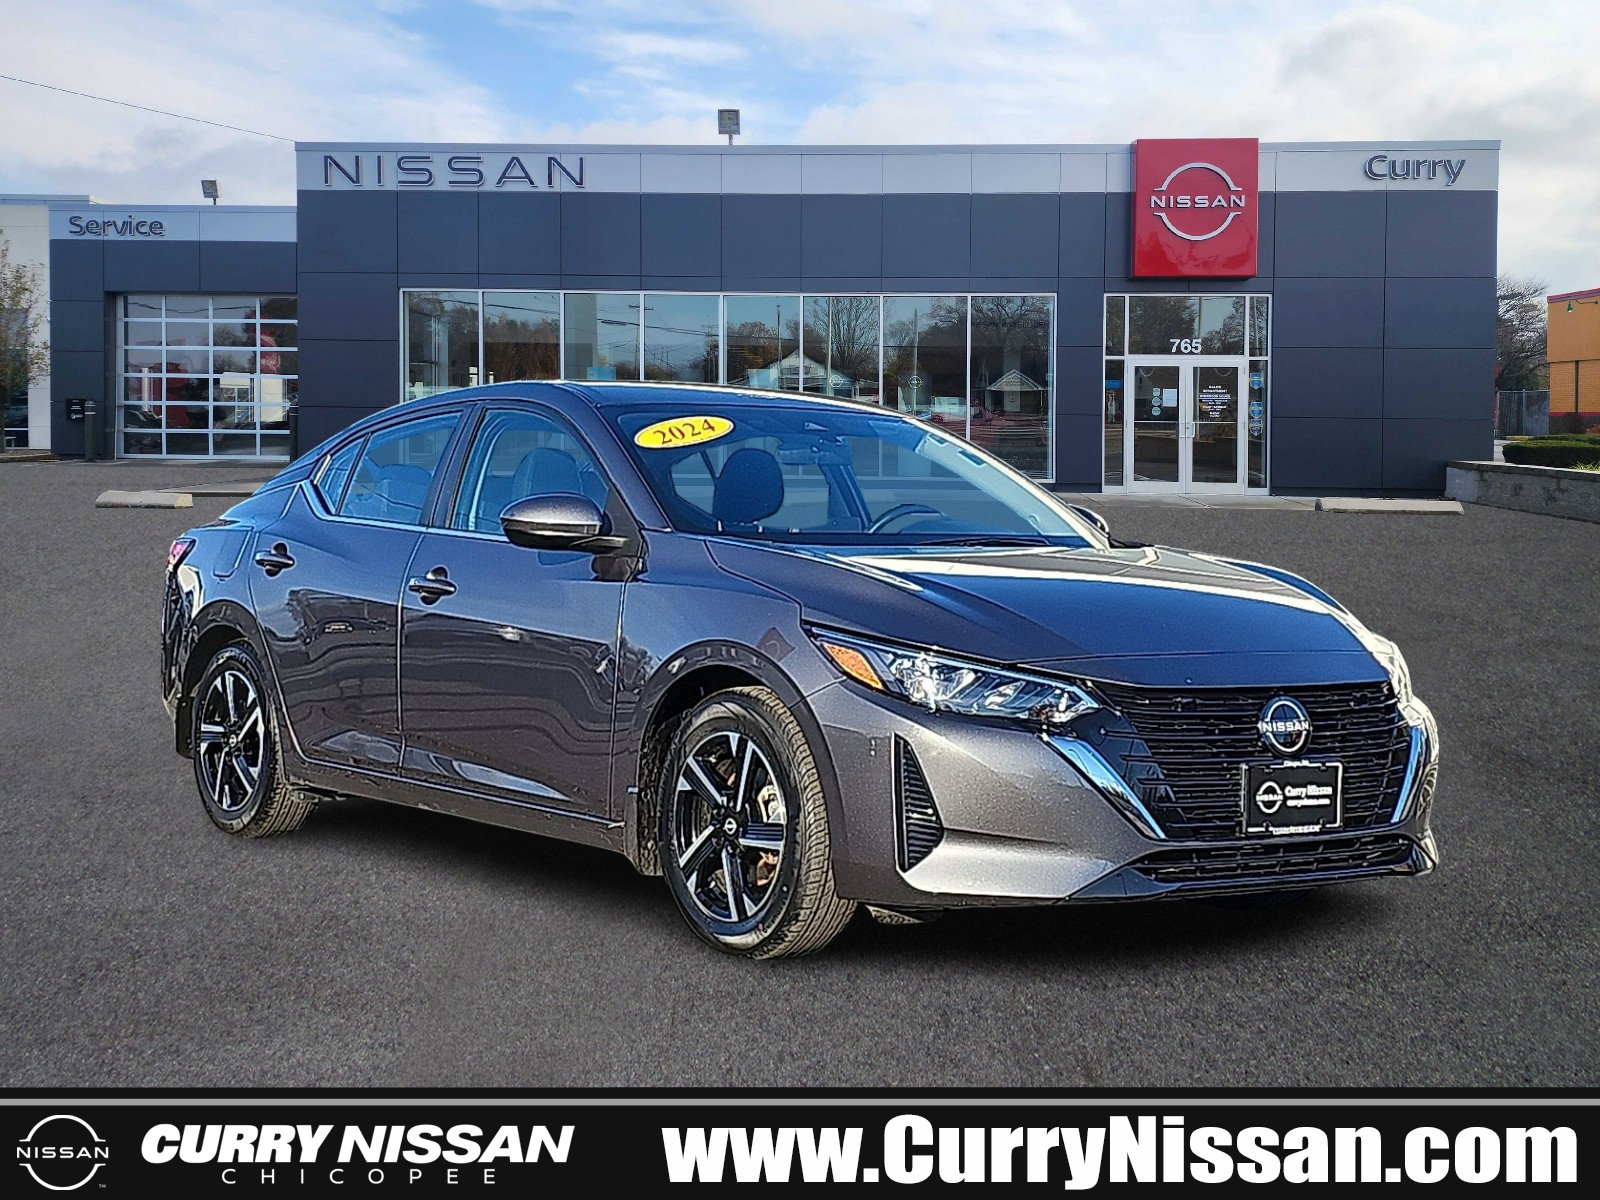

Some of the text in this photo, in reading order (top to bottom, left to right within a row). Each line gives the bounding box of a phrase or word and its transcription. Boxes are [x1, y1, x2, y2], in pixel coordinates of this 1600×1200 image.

[324, 155, 586, 188] NISSAN
[1365, 154, 1466, 186] Curry
[1150, 194, 1246, 208] NISSAN
[68, 214, 165, 237] Service
[1170, 338, 1202, 354] 765
[653, 418, 715, 445] 2024
[1262, 719, 1309, 732] NISSAN
